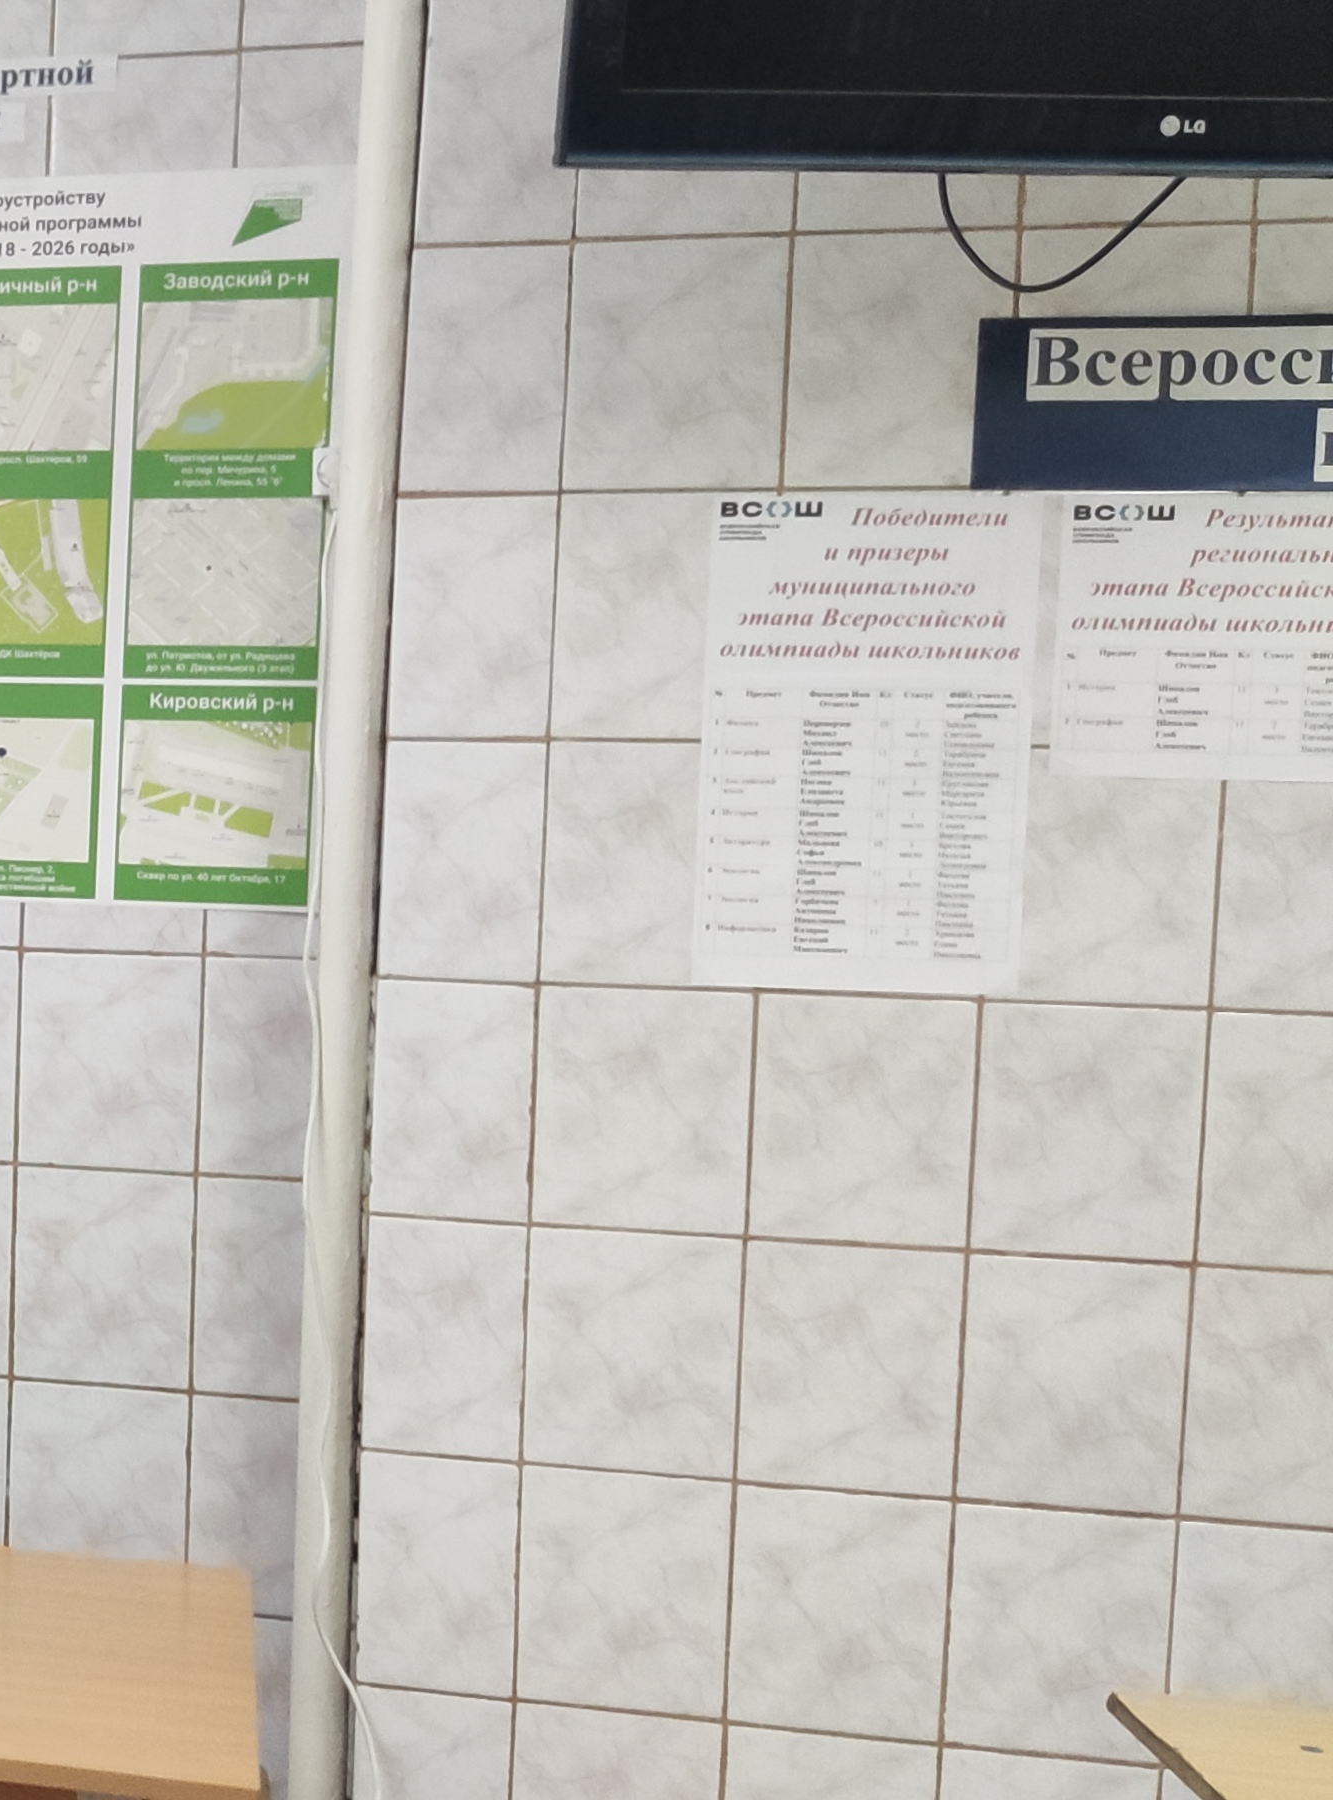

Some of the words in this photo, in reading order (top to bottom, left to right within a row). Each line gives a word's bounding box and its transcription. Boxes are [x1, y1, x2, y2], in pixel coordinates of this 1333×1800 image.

[1183, 119, 1206, 135] LG
[35, 215, 142, 236] программы
[31, 239, 75, 257] 2026
[80, 241, 135, 258] годы»
[67, 279, 97, 296] р-н
[163, 269, 272, 292] Заводский
[277, 272, 309, 290] р-н
[851, 507, 1009, 527] Победители
[824, 547, 839, 561] и
[846, 546, 950, 566] призеры
[768, 579, 977, 600] муниципального
[1090, 581, 1169, 597] этапа
[737, 610, 814, 627] этапа
[821, 608, 1007, 632] Всероссийской
[1071, 613, 1217, 632] олимпиады
[719, 641, 861, 659] олимпиады
[868, 645, 1021, 661] школьников
[149, 692, 257, 713] Кировский
[263, 697, 294, 714] р-н
